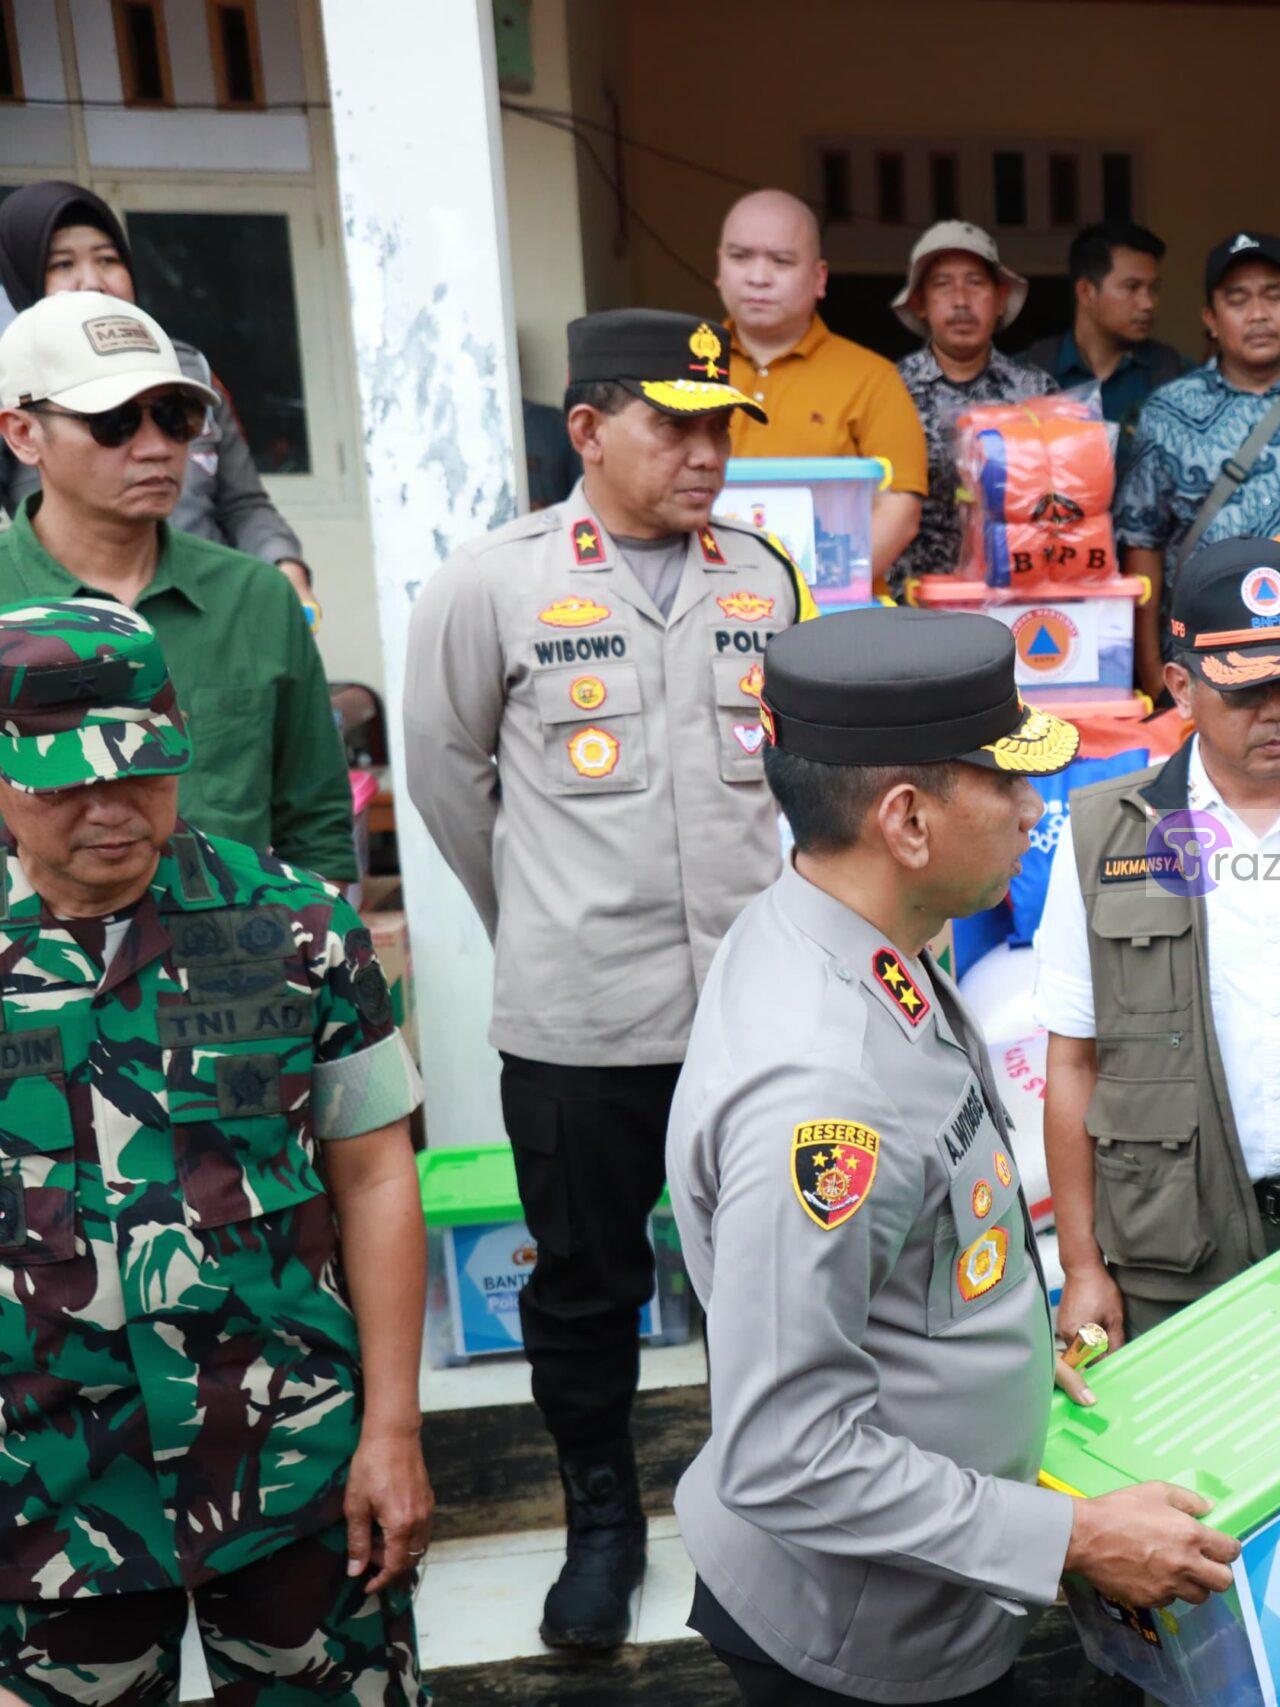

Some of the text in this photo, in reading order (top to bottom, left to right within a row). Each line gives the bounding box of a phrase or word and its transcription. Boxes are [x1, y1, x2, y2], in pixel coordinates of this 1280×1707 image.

[534, 634, 626, 665] WIBOWO
[169, 1006, 302, 1037] TNI AD
[800, 1124, 876, 1151] RESERSE
